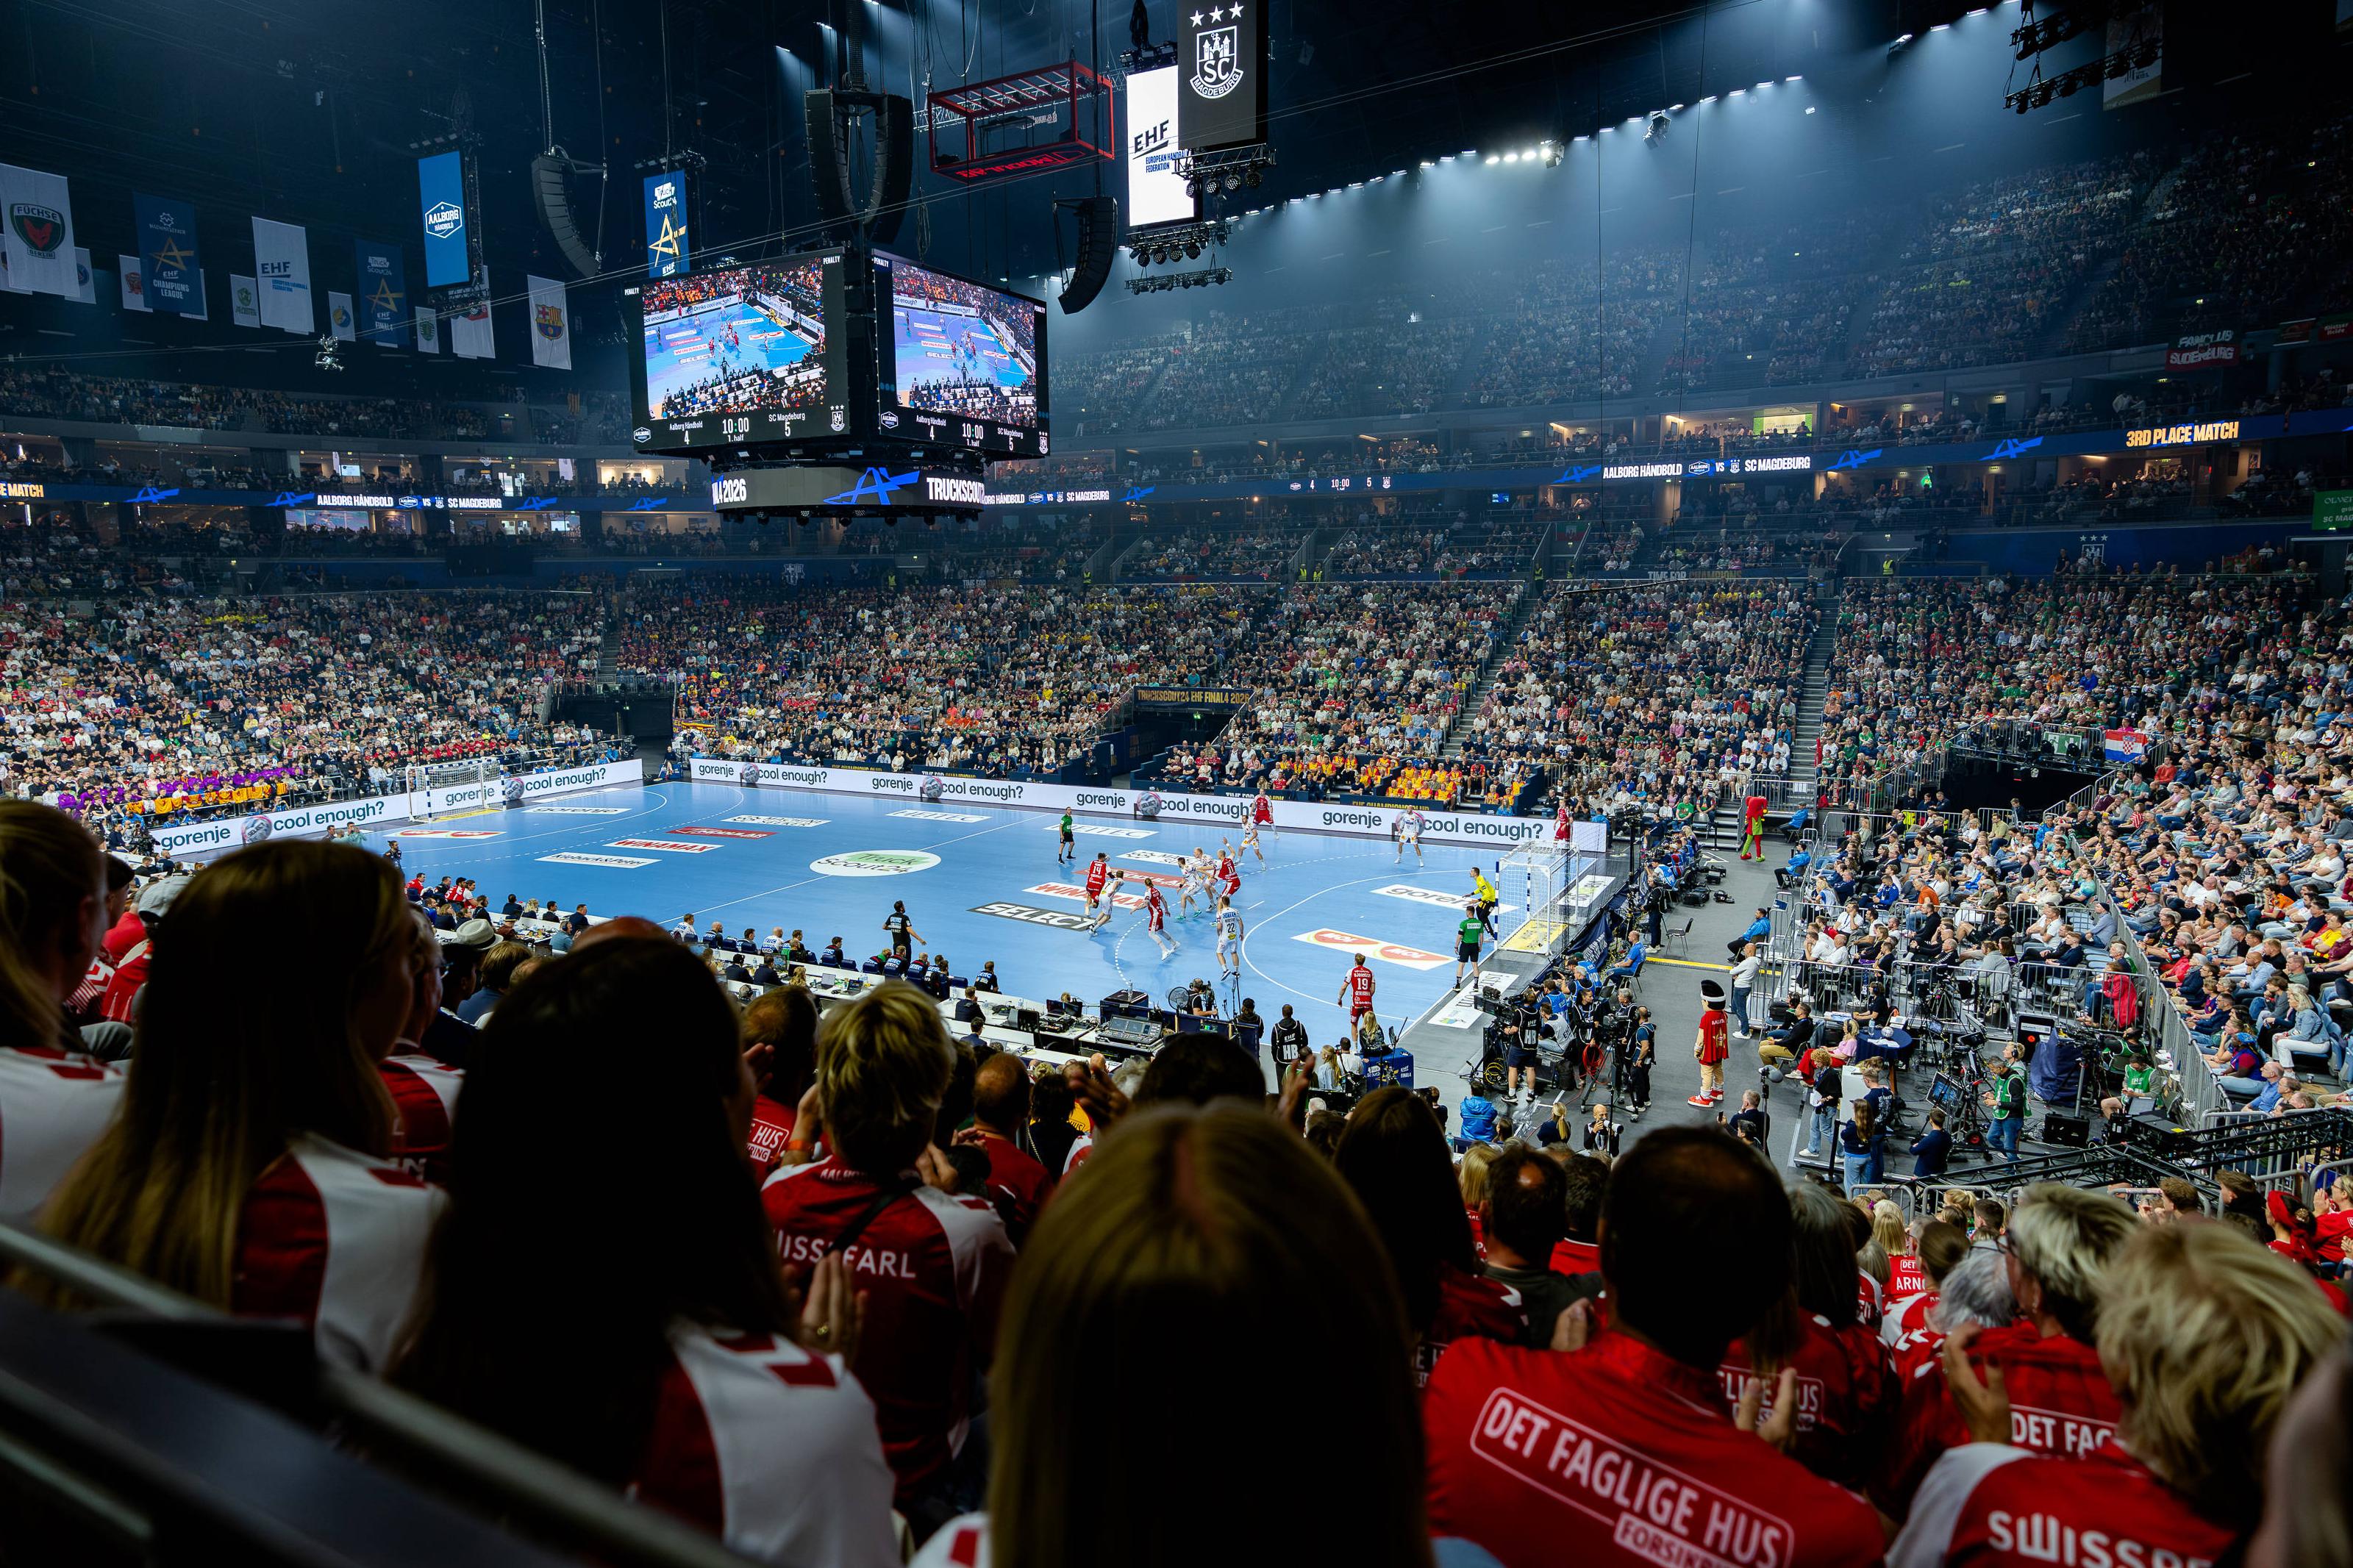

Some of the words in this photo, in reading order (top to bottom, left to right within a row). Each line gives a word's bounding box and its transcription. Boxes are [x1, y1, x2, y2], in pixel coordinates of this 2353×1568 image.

[1204, 57, 1230, 82] SC
[1193, 71, 1240, 96] MAGDEBURG
[1134, 119, 1169, 154] EHF
[1146, 153, 1167, 164] EUROPEAN
[1146, 162, 1170, 173] FEDERATION
[17, 205, 57, 221] FÜCHSE
[428, 210, 459, 224] AALBORG
[823, 255, 840, 265] PENALTY
[874, 257, 888, 267] PENALTY
[261, 262, 290, 274] EHF
[663, 262, 675, 273] EHF
[153, 279, 189, 293] CHAMPIONS
[624, 287, 639, 296] PENALTY
[161, 289, 184, 299] LEAGUE
[768, 414, 776, 422] SC
[777, 413, 805, 423] Magdeburg
[916, 415, 930, 426] Aalborg
[930, 417, 946, 426] Håndbold
[669, 423, 685, 432] Aalborg
[685, 420, 703, 429] Håndbold
[722, 418, 749, 434] 10:00
[785, 422, 791, 437] 5
[929, 426, 935, 440] 4
[963, 423, 984, 440] 10:00
[997, 427, 1003, 435] SC
[1004, 428, 1023, 439] Magdeburg
[684, 430, 690, 445] 4
[2127, 429, 2151, 447] 3RD
[2153, 425, 2192, 445] PLACE
[2193, 421, 2239, 442] MATCH
[1009, 437, 1013, 451] 5
[1715, 462, 1724, 472] VS
[1745, 459, 1757, 470] SC
[1758, 457, 1810, 470] MAGDEBURG
[1603, 465, 1639, 479] AALBORG
[1640, 463, 1682, 477] HÅNDBOLD
[1310, 480, 1315, 490] 4
[1331, 479, 1349, 487] 10:00
[1366, 477, 1371, 487] 5
[8, 484, 44, 498] MATCH
[724, 479, 747, 503] 2026
[996, 492, 1024, 504] HÅNDBOLD
[1066, 493, 1074, 501] SC
[1075, 491, 1109, 501] MAGDEBURG
[318, 495, 352, 506] AALBORG
[353, 493, 393, 507] HÅNDBOLD
[423, 499, 431, 507] VS
[448, 498, 458, 508] SC
[459, 498, 501, 509] MAGDEBURG
[1138, 690, 1189, 703] TRUCKSCOUT24
[1190, 692, 1204, 703] EHF
[1204, 692, 1229, 704] FINAL4
[1230, 692, 1250, 704] 2026
[526, 776, 551, 792] cool
[555, 767, 606, 787] enough?
[699, 764, 734, 778] gorenje
[759, 770, 779, 780] cool
[782, 770, 827, 785] enough?
[872, 776, 913, 790] gorenje
[942, 781, 966, 794] cool
[969, 784, 1024, 801] enough?
[1076, 793, 1125, 809] gorenje
[1161, 798, 1190, 812] cool
[161, 826, 230, 851] gorenje
[274, 812, 310, 831] cool
[315, 801, 384, 824] enough?
[1323, 810, 1382, 828] gorenje
[1425, 817, 1459, 834] cool
[1464, 820, 1543, 840] enough?
[615, 840, 713, 851] WINAMAX
[818, 858, 912, 873] Scout24
[860, 853, 918, 865] Truck
[1093, 866, 1101, 875] 14
[977, 903, 1096, 929] SELECT
[1227, 923, 1235, 933] 22
[1319, 933, 1360, 943] MOL
[1385, 948, 1427, 959] MOL
[1357, 978, 1368, 990] 19
[1284, 1033, 1296, 1041] EHF
[1282, 1045, 1299, 1059] HB
[753, 1125, 783, 1149] HUS
[2011, 1413, 2058, 1449] DET
[1482, 1396, 1551, 1459] DET
[1547, 1428, 1701, 1537] FAGLIGE
[1703, 1500, 1784, 1568] HUS
